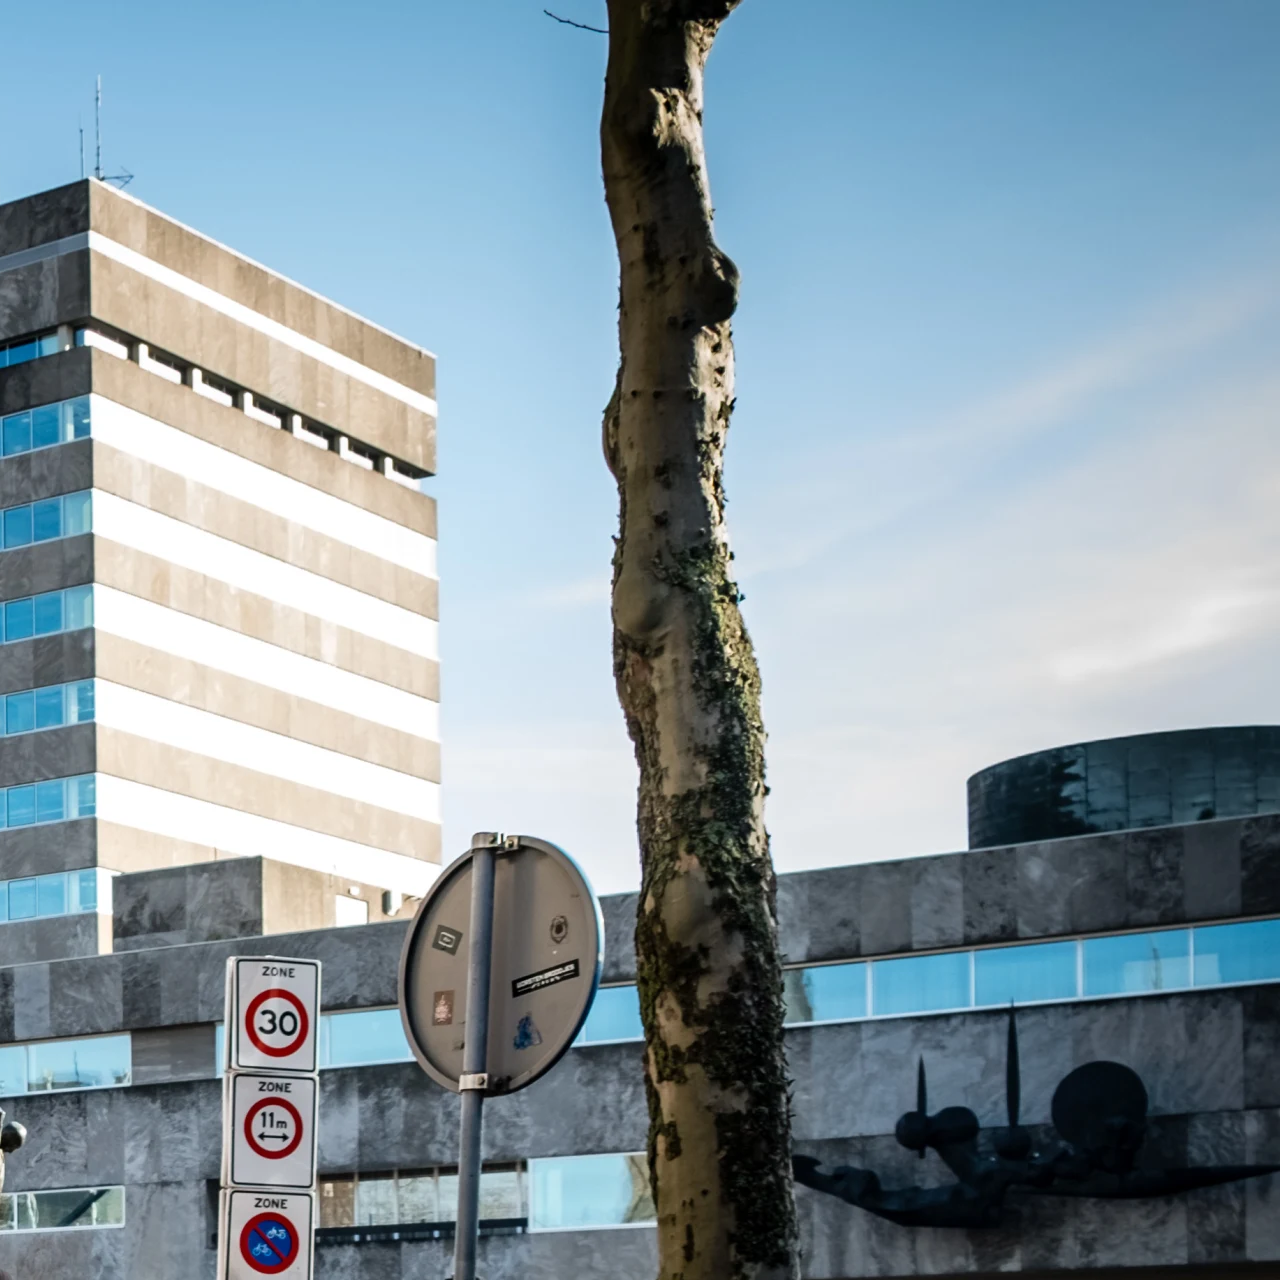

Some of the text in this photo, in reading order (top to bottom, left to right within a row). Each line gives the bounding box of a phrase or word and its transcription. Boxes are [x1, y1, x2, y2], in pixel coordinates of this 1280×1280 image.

[261, 966, 296, 979] ZONE
[258, 1009, 298, 1036] 30
[258, 1082, 292, 1094] ZONE
[254, 1197, 288, 1210] ZONE
